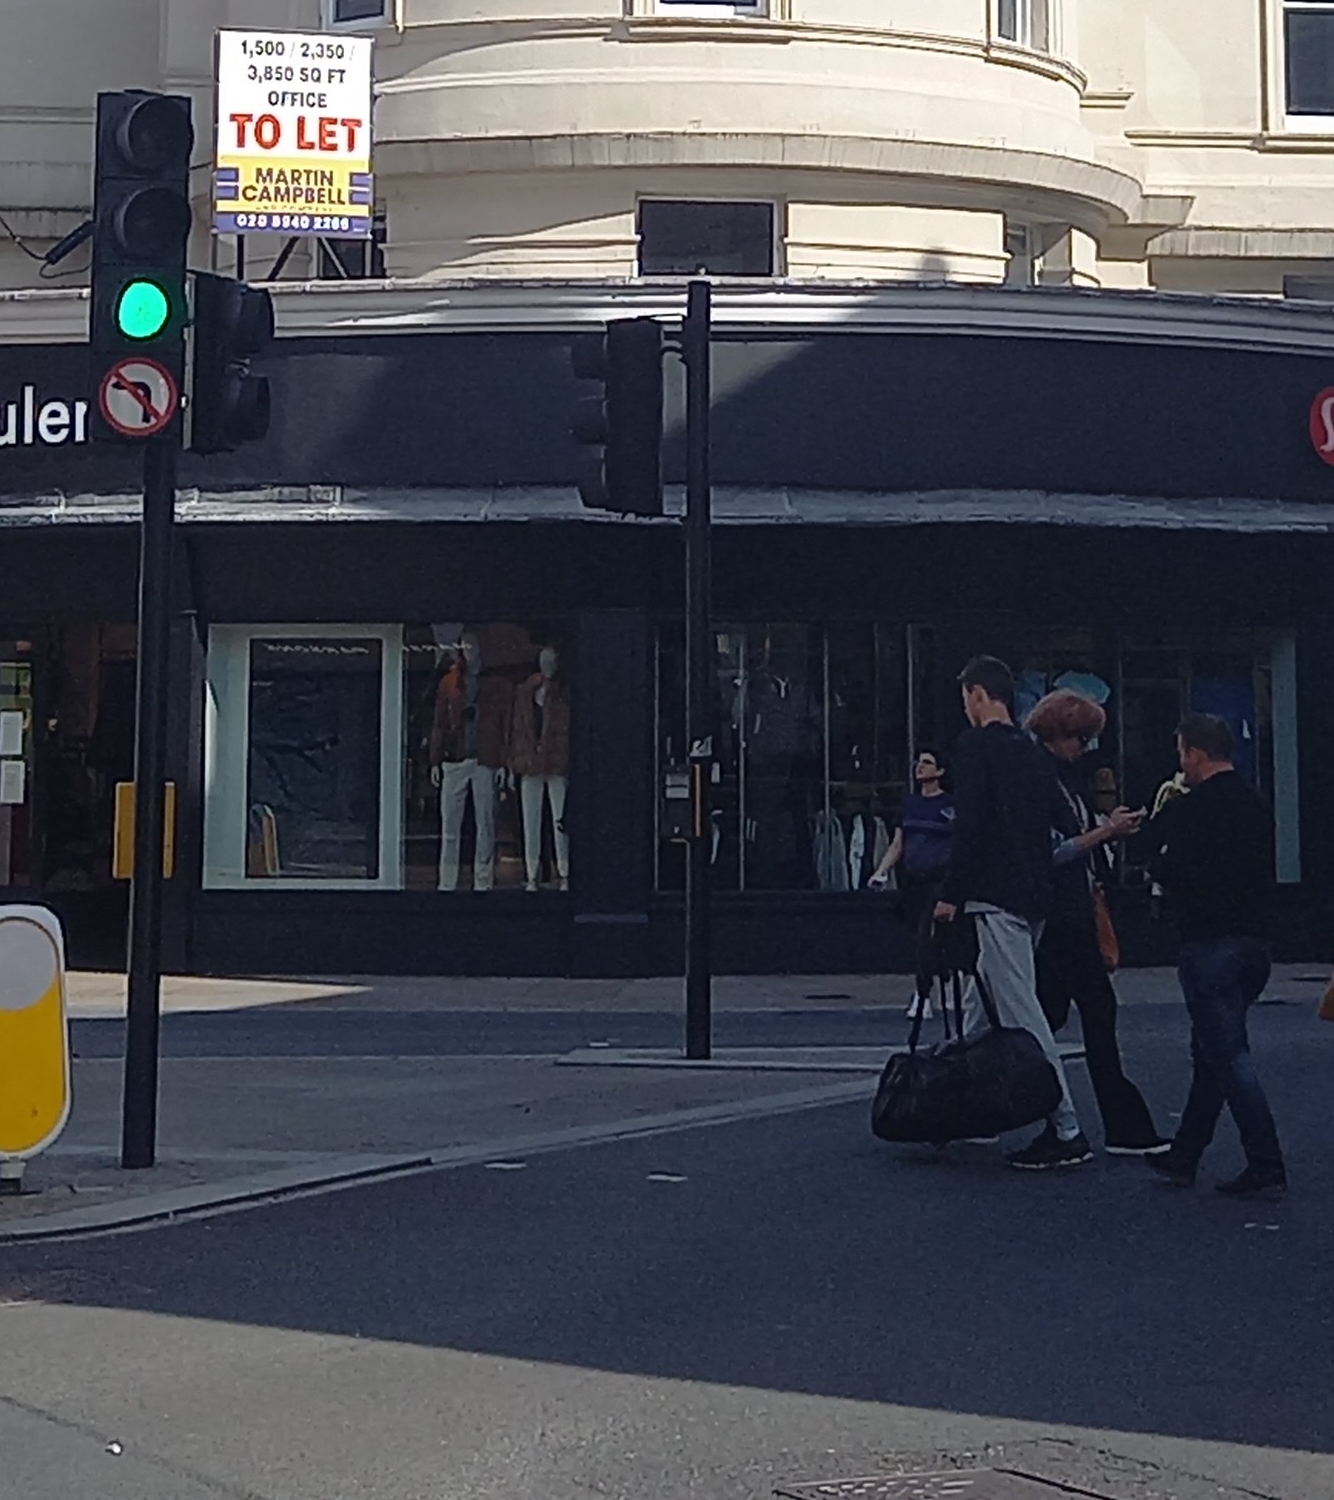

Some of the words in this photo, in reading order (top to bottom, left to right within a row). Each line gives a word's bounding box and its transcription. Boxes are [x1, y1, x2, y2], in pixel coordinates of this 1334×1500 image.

[241, 40, 285, 58] 1,500
[300, 43, 345, 61] 2,350
[247, 65, 294, 83] 3,850
[299, 68, 322, 83] SQ
[327, 69, 346, 83] FT
[267, 91, 328, 108] OFFICE
[229, 113, 281, 149] TO
[296, 115, 362, 152] LET
[255, 167, 334, 187] MARTIN
[242, 185, 346, 205] CAMPBELL
[236, 213, 267, 227] 020
